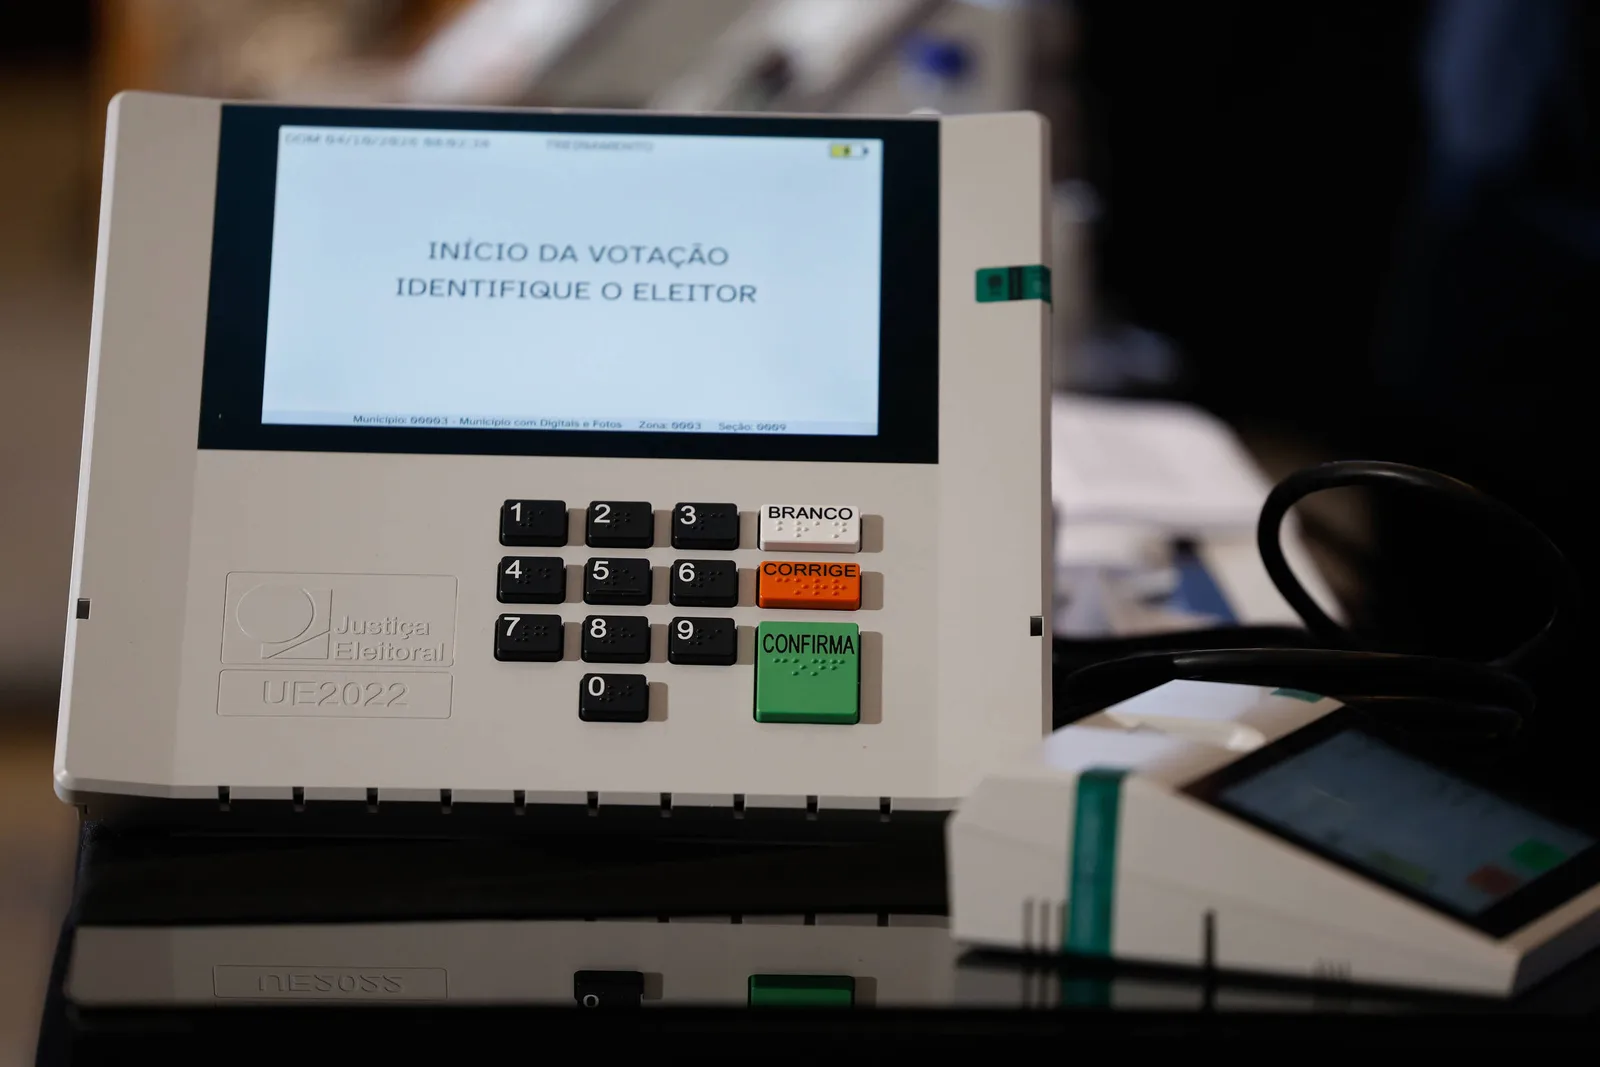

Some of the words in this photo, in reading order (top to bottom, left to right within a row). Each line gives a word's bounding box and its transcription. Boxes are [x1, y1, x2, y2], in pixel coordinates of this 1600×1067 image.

[428, 238, 528, 263] INÍCIO
[539, 243, 579, 263] DA
[588, 243, 729, 269] VOTAÇÃO
[396, 277, 590, 300] IDENTIFIQUE
[601, 281, 623, 301] O
[633, 281, 757, 303] ELEITOR
[540, 418, 579, 429] Digitais
[593, 420, 622, 429] Fotos
[639, 421, 668, 430] Zona:
[719, 422, 752, 432] Seção:
[510, 503, 522, 522] 1
[594, 504, 611, 523] 2
[680, 506, 697, 525] 3
[768, 506, 853, 521] BRANCO
[505, 560, 522, 579] 4
[592, 561, 609, 580] 5
[679, 563, 695, 582] 6
[763, 563, 857, 578] CORRIGE
[334, 615, 431, 639] Justiça
[504, 617, 521, 636] 7
[590, 619, 607, 638] 8
[677, 620, 694, 640] 9
[333, 641, 445, 662] Eleitoral
[763, 633, 855, 655] CONFIRMA
[262, 680, 409, 707] UE2022
[588, 676, 605, 696] 0
